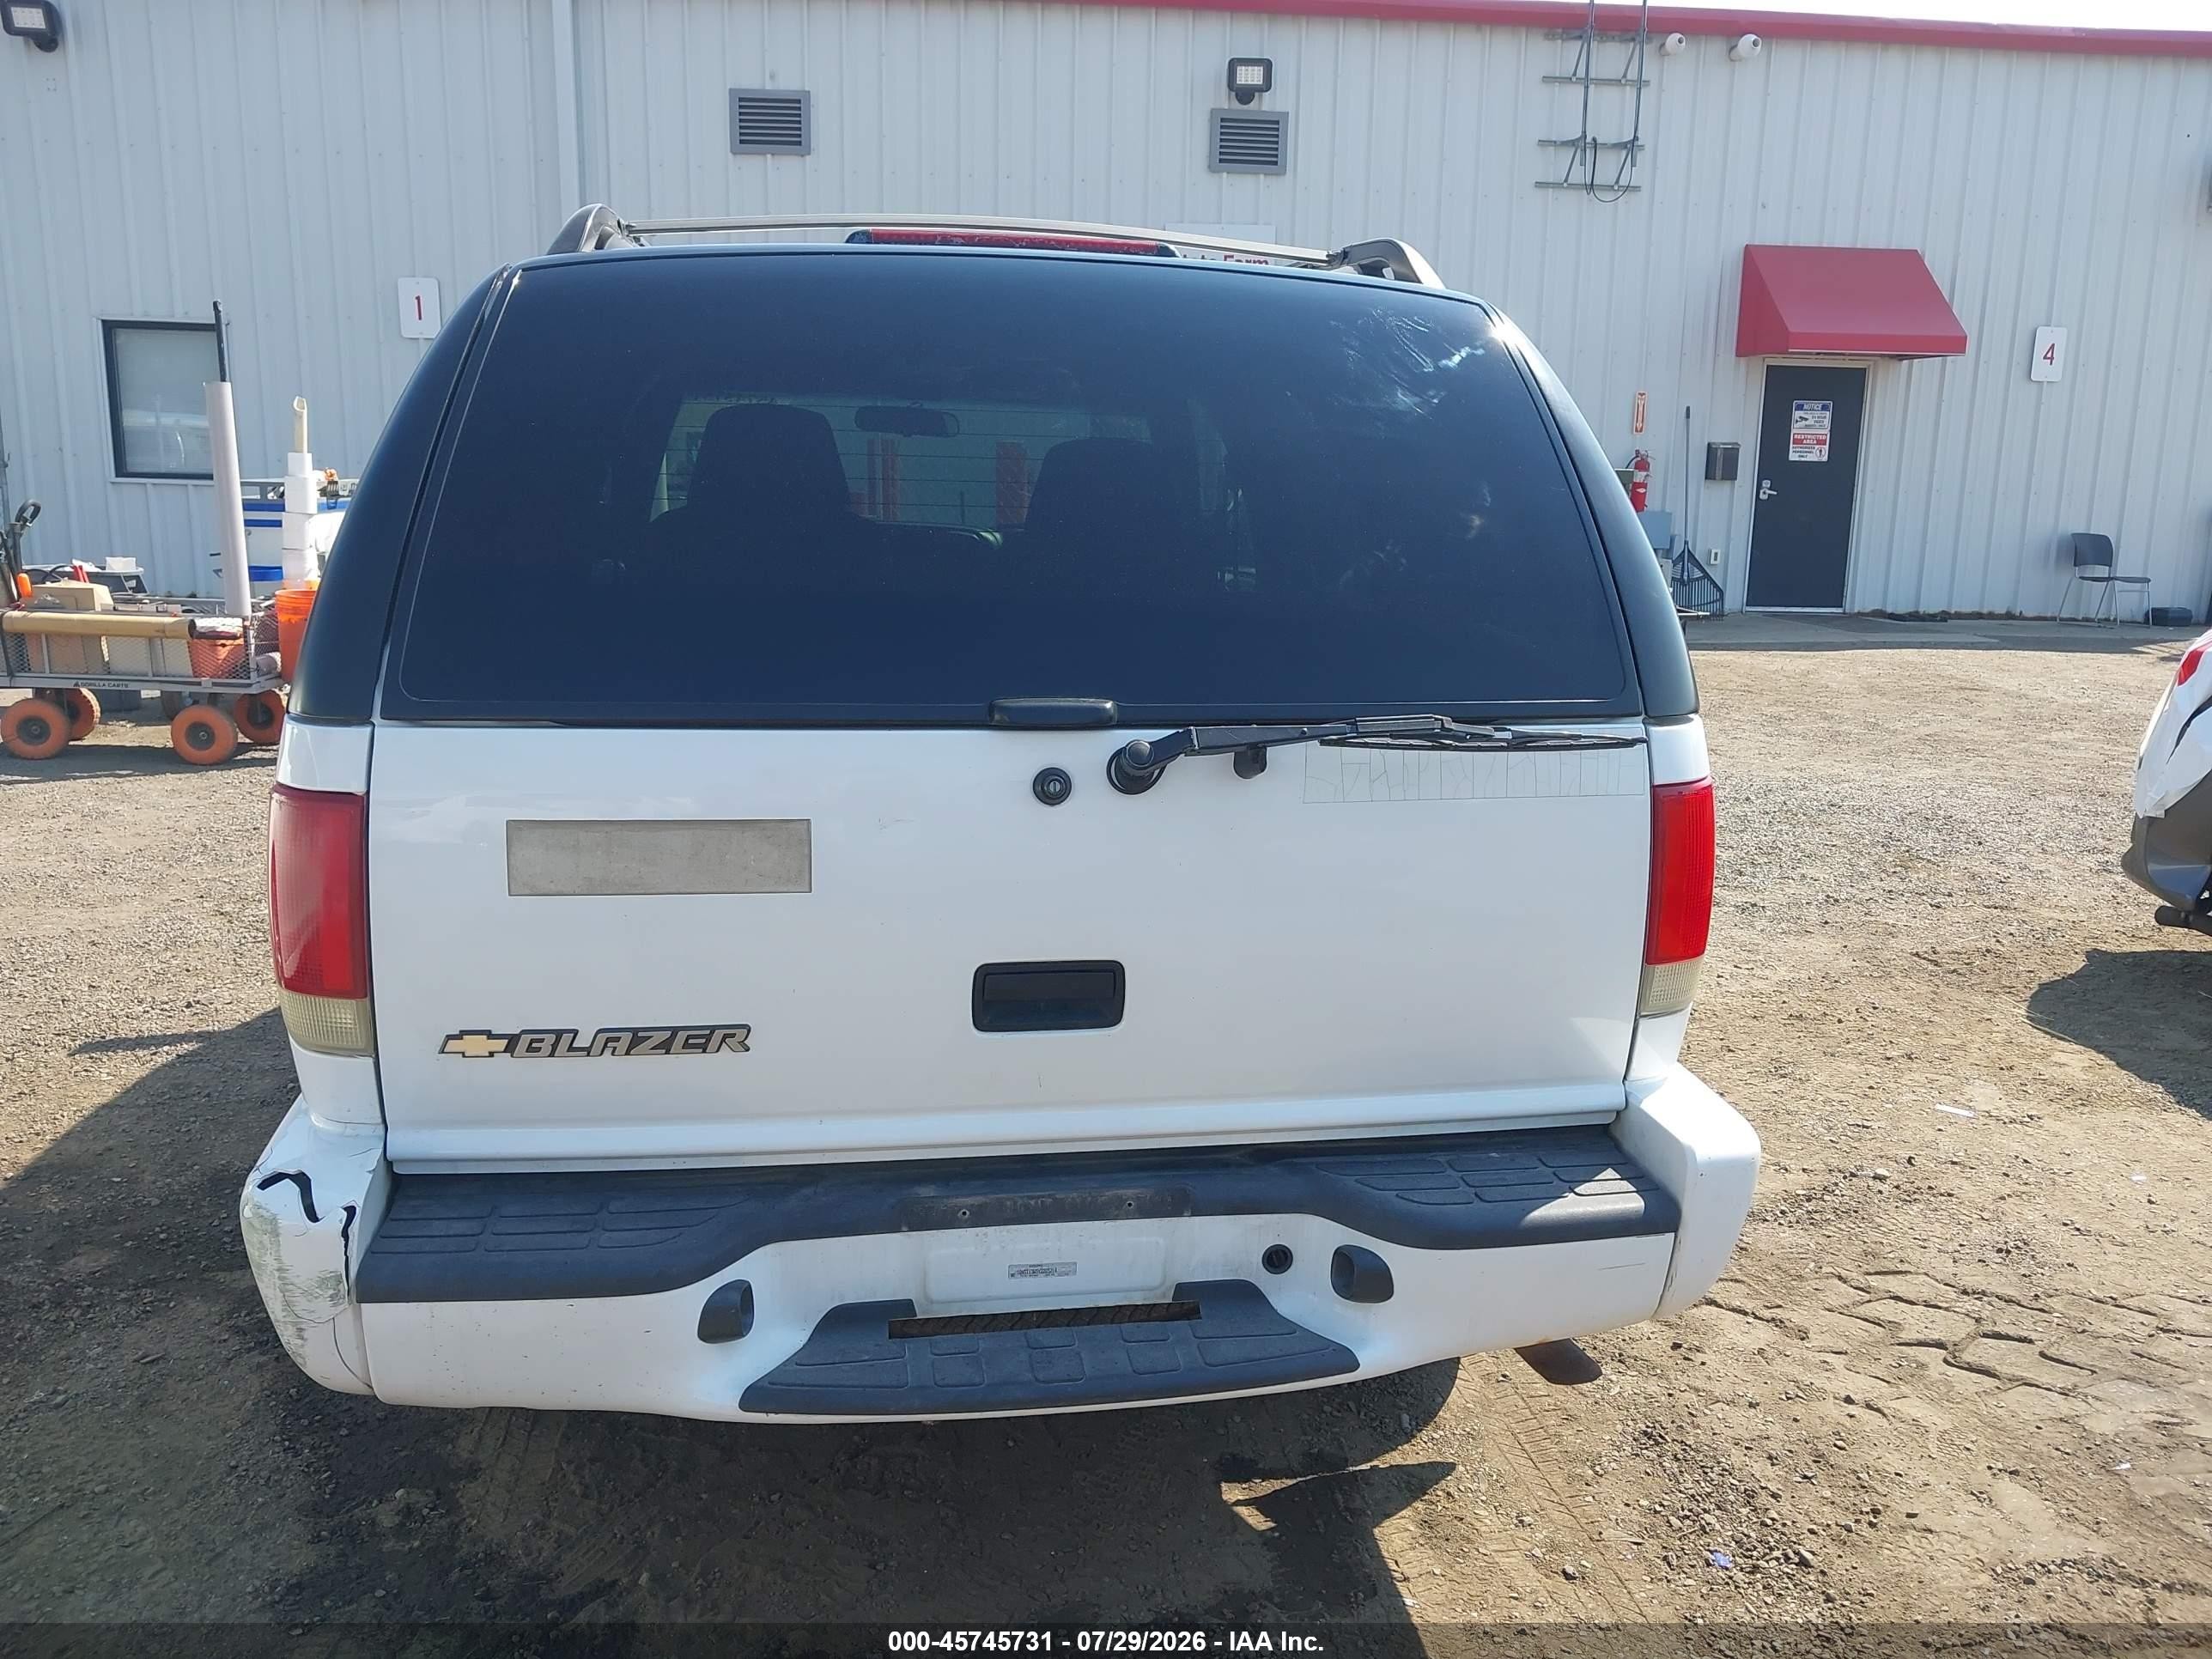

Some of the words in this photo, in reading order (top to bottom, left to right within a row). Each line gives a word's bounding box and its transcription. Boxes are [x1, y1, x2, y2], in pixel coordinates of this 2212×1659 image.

[415, 295, 422, 320] 1
[2043, 343, 2055, 366] 4
[512, 1024, 750, 1058] BLAZER
